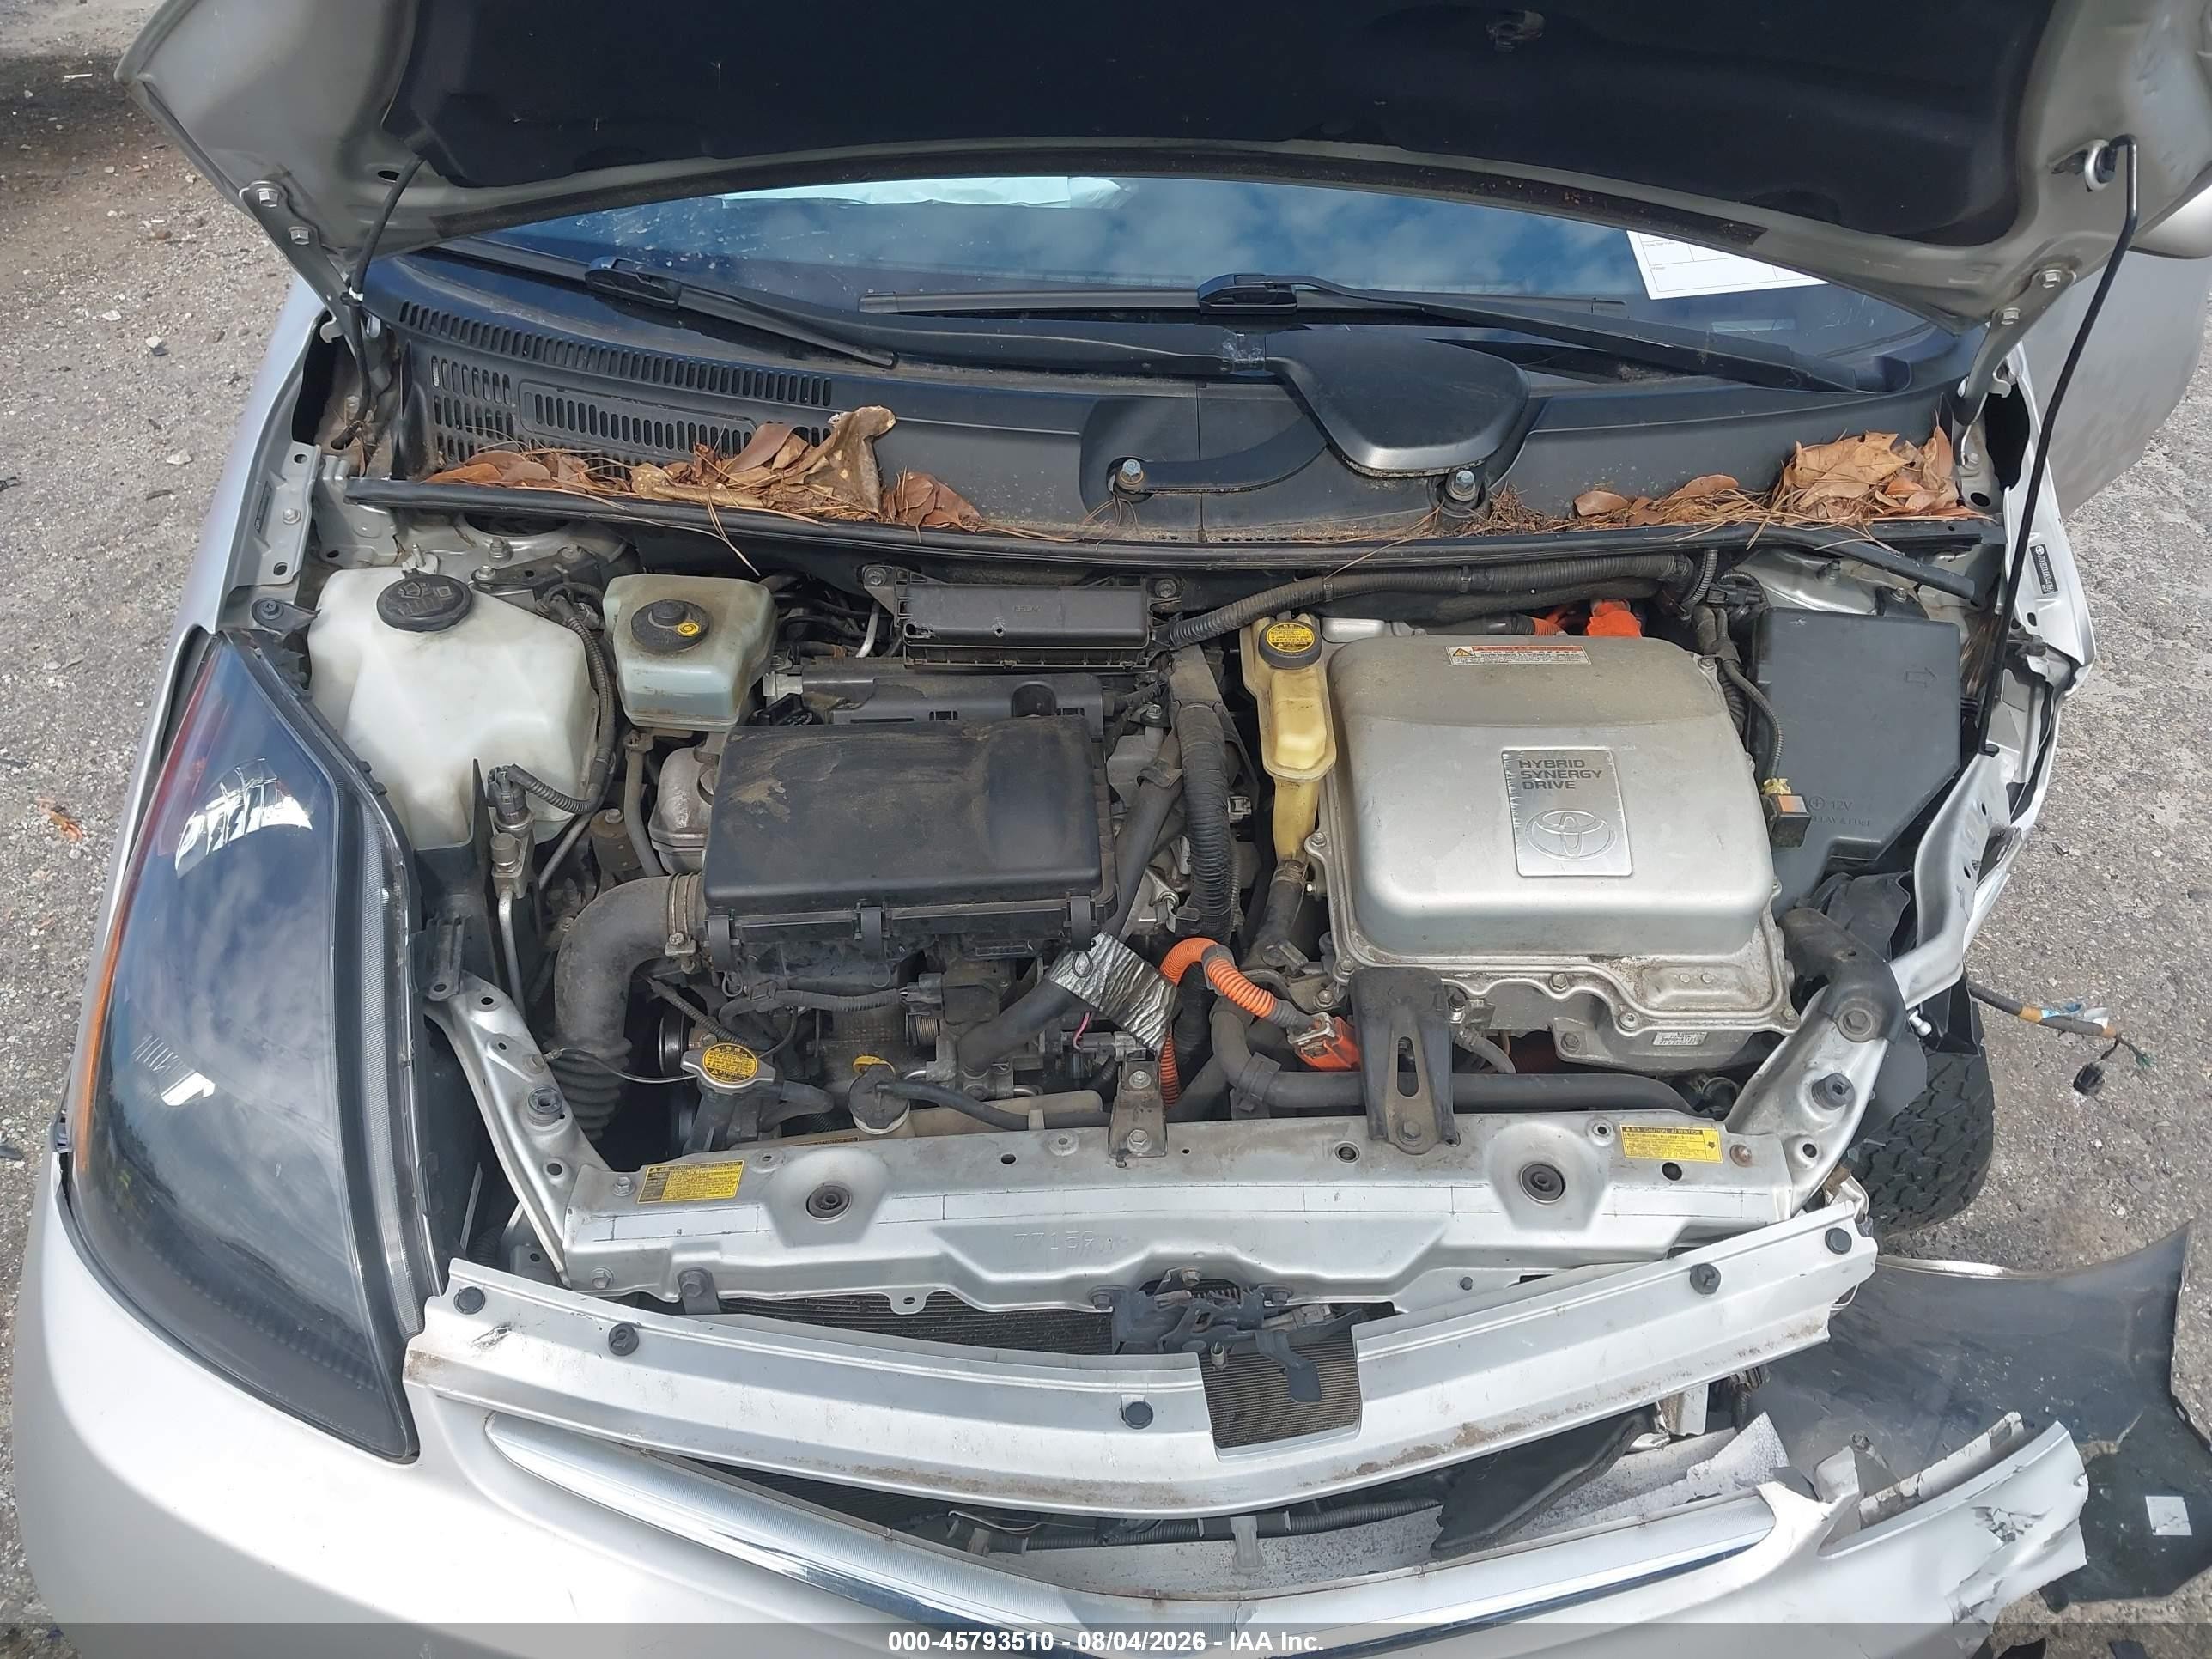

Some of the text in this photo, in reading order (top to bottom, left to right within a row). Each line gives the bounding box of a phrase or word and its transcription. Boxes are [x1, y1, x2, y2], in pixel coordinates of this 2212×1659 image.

[1519, 759, 1585, 768] HYBRID
[1520, 769, 1602, 779] SYNERGY
[1522, 781, 1576, 790] DRIVE
[1831, 800, 1853, 811] 12V
